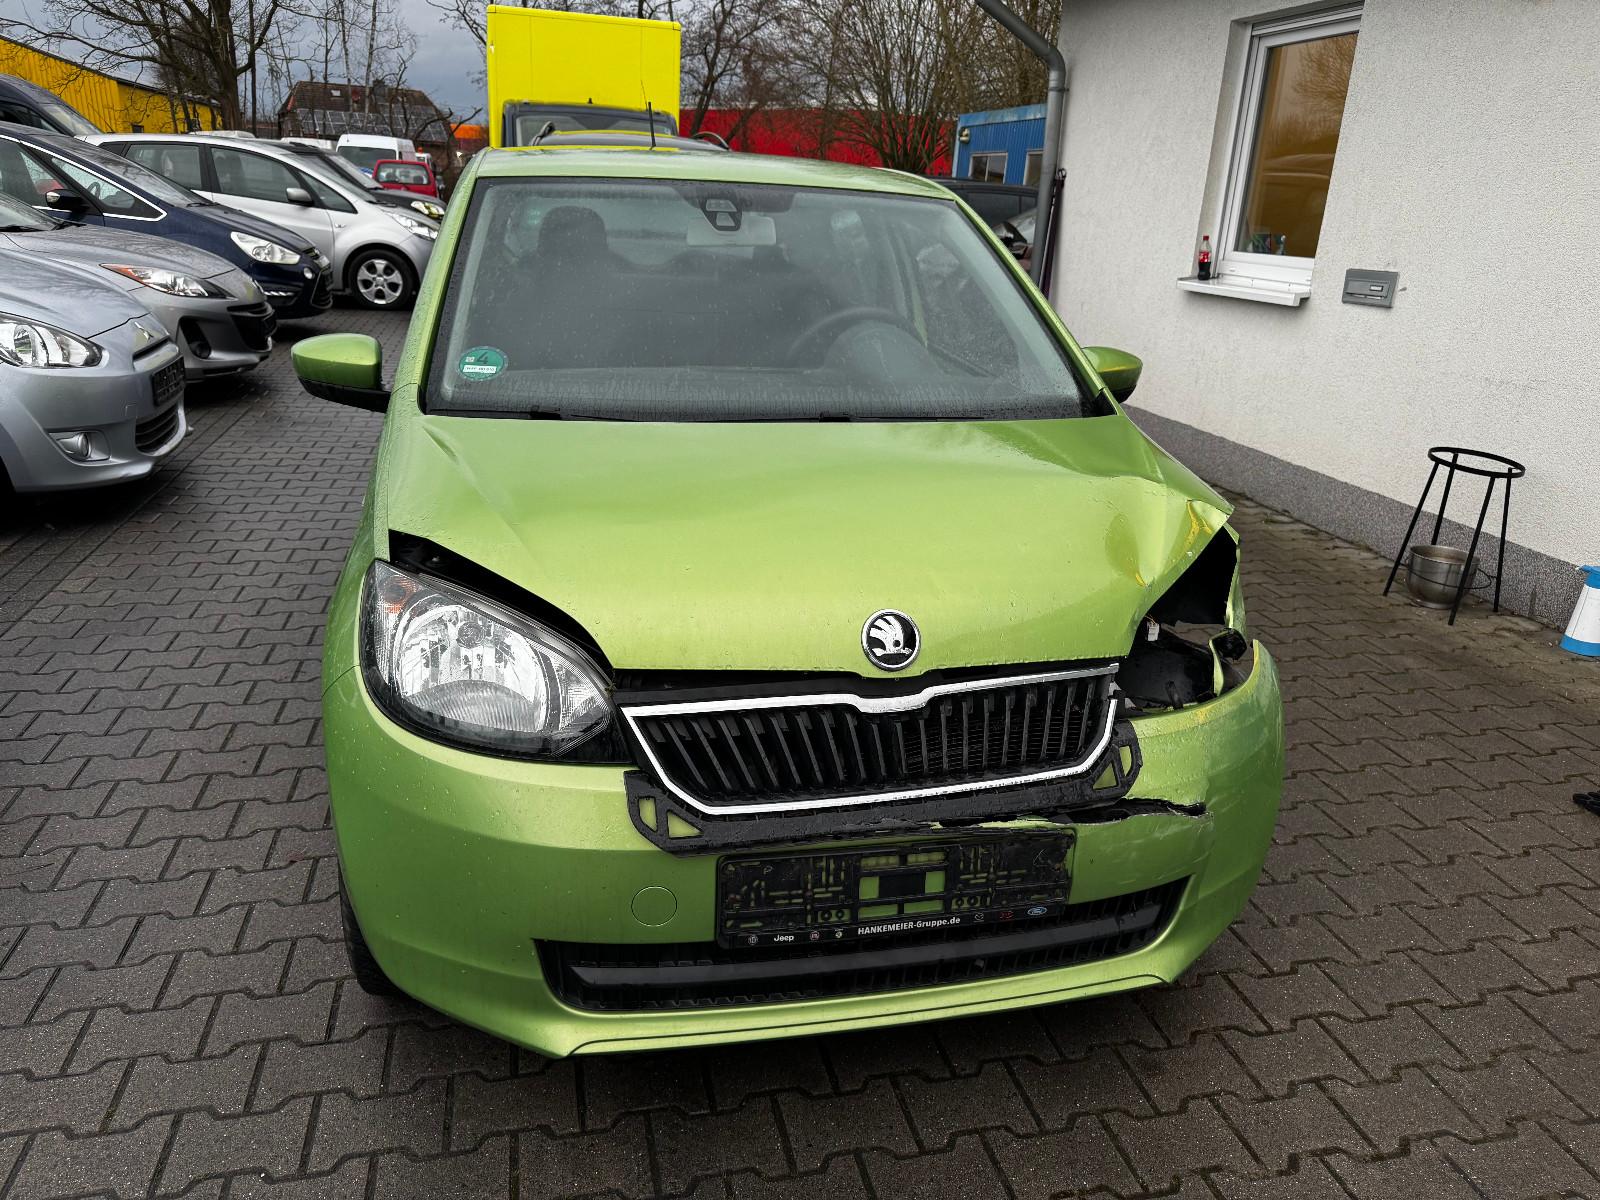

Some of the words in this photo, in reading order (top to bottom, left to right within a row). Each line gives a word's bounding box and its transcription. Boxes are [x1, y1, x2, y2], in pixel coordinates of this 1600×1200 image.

[477, 351, 488, 364] 4
[857, 916, 961, 935] HANKEMEIER-Gruppe.de
[773, 934, 795, 942] Jeep
